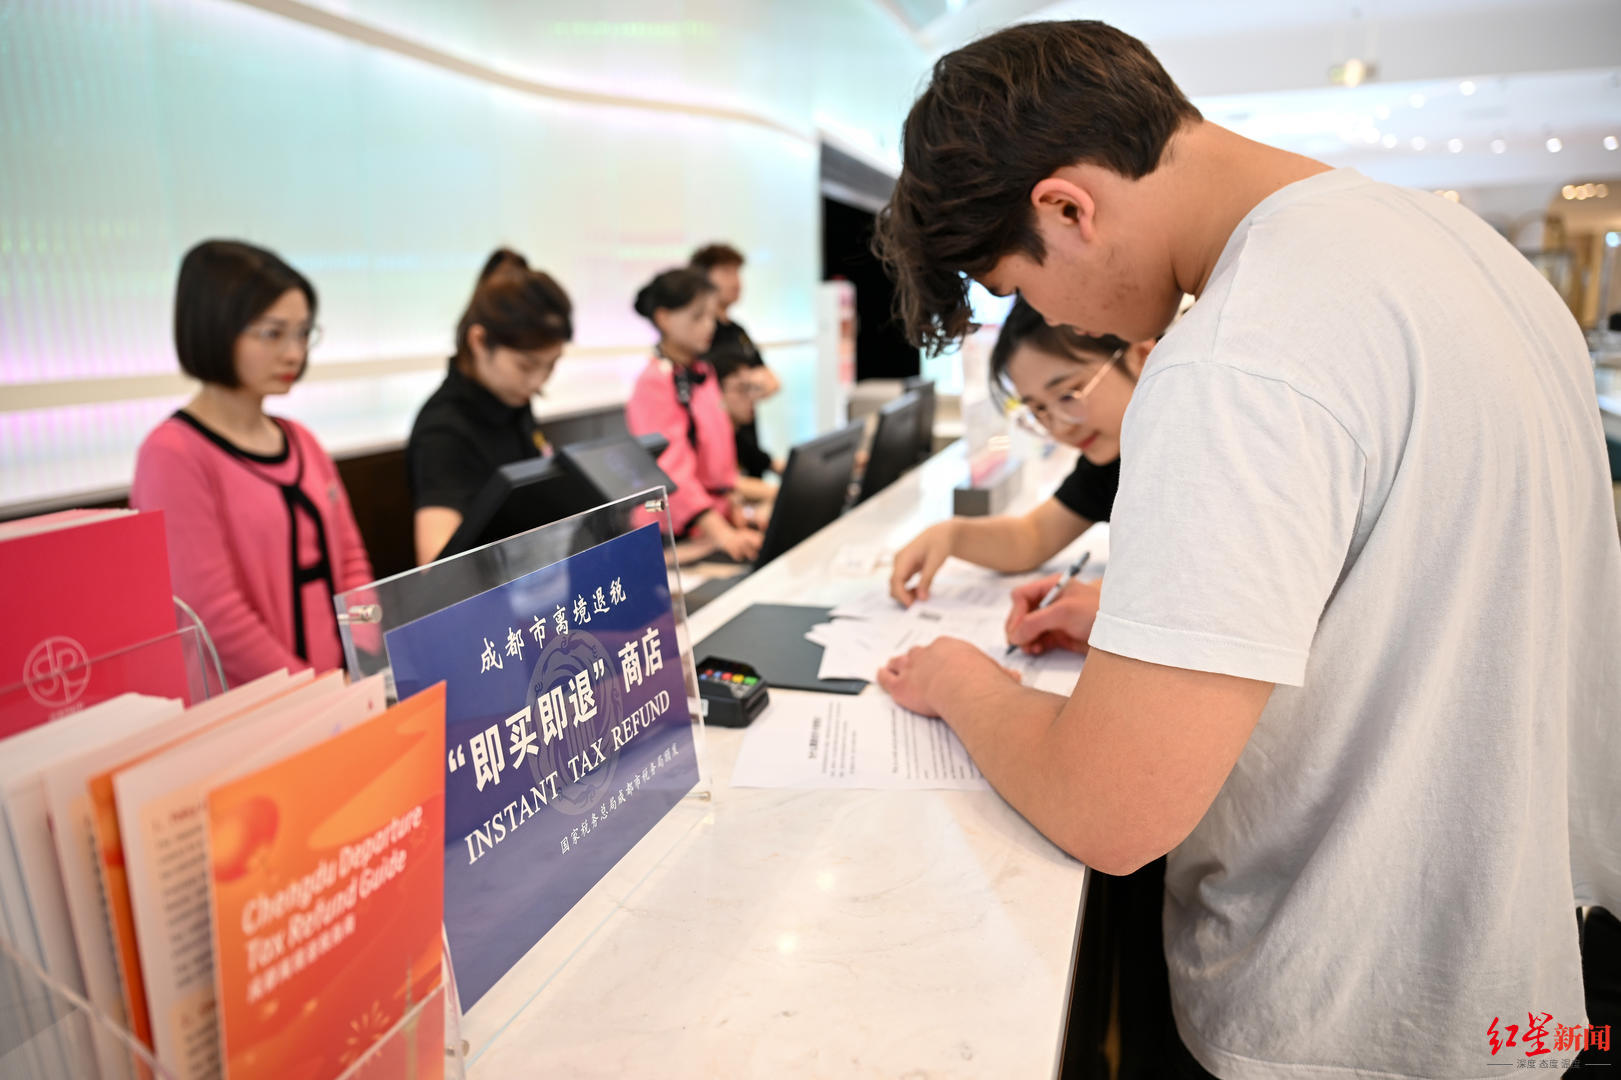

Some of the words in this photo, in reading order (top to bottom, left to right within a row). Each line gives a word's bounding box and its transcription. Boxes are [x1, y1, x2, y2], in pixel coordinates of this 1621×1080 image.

[480, 576, 627, 674] 成都市离境退税
[464, 771, 559, 865] INSTANT
[567, 738, 607, 783] TAX
[611, 690, 671, 752] REFUND
[241, 858, 338, 937] Chengdu
[338, 806, 423, 878] Departure
[246, 930, 286, 973] Tax
[287, 876, 358, 948] Refund
[359, 848, 407, 899] Guide
